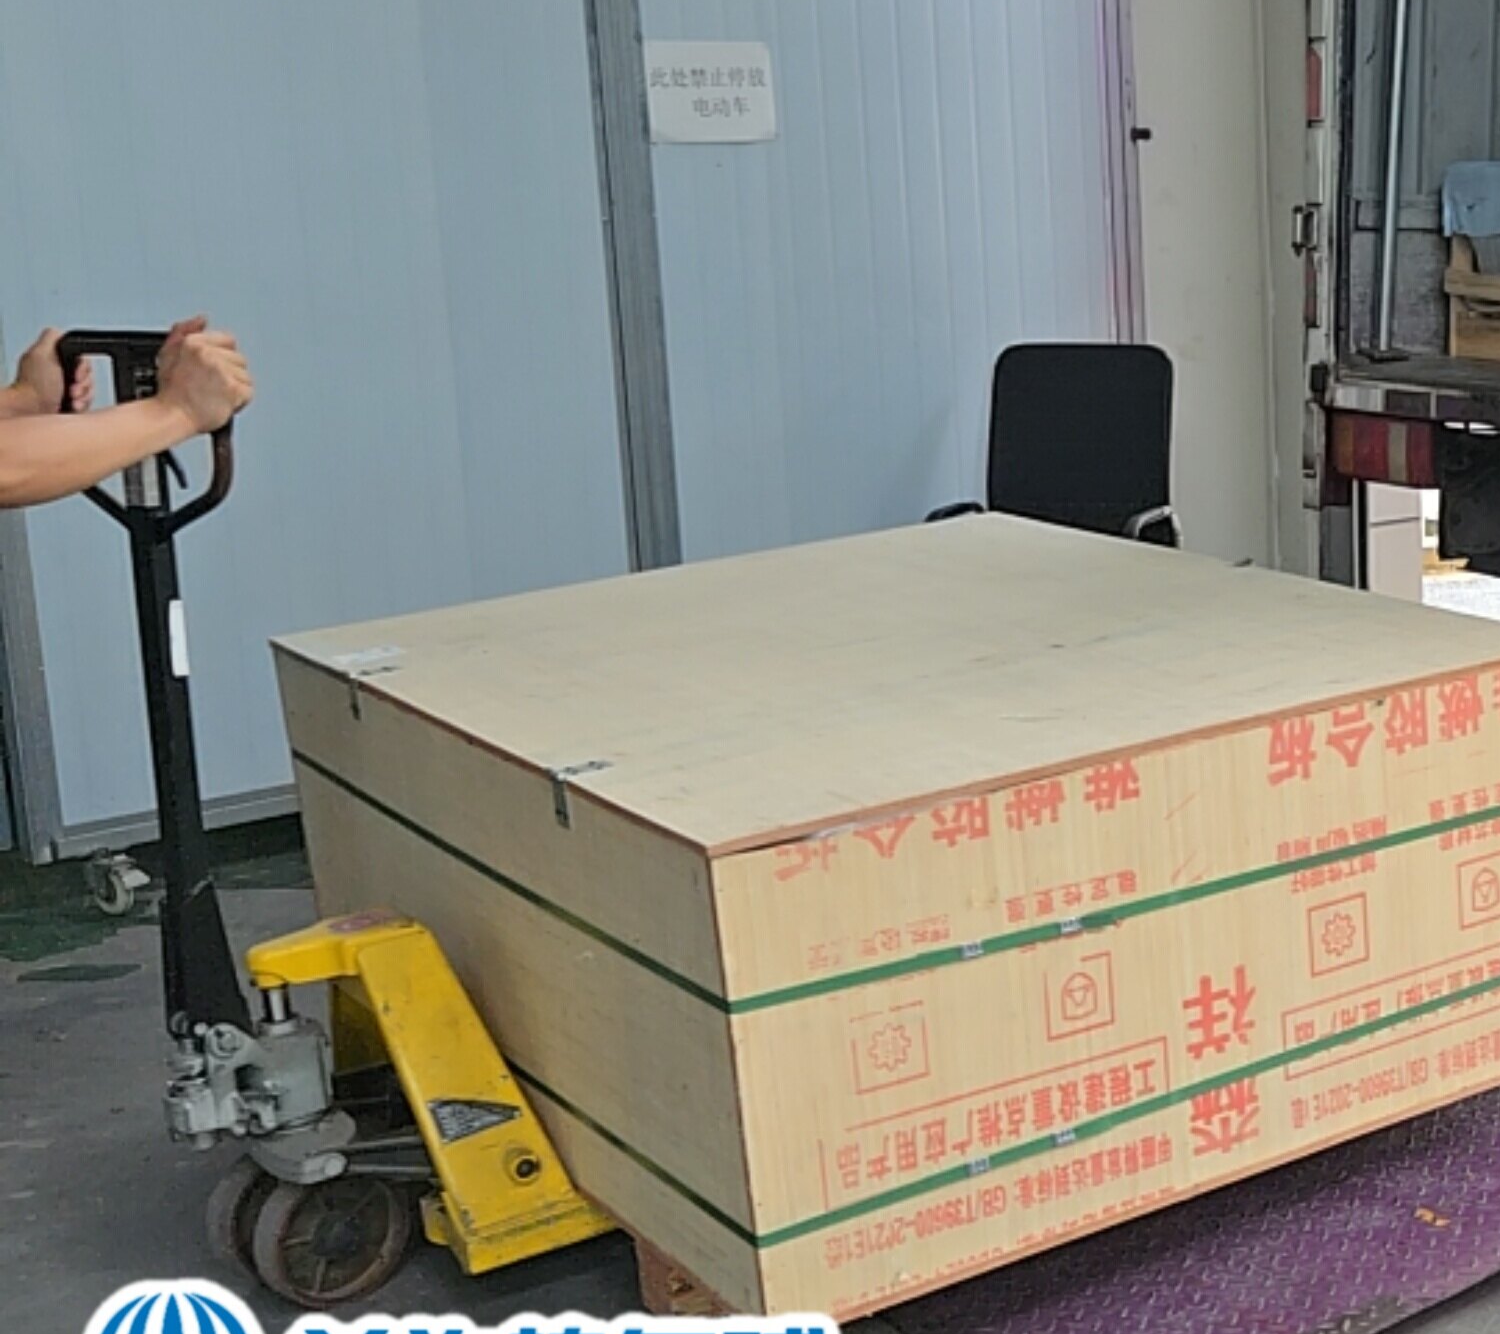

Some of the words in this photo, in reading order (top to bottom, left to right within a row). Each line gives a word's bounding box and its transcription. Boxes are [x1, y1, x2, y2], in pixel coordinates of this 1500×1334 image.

[649, 66, 767, 89] 此处禁止停放
[692, 96, 751, 118] 电动车
[836, 1058, 1157, 1190] 工程建设重点推广应用产品
